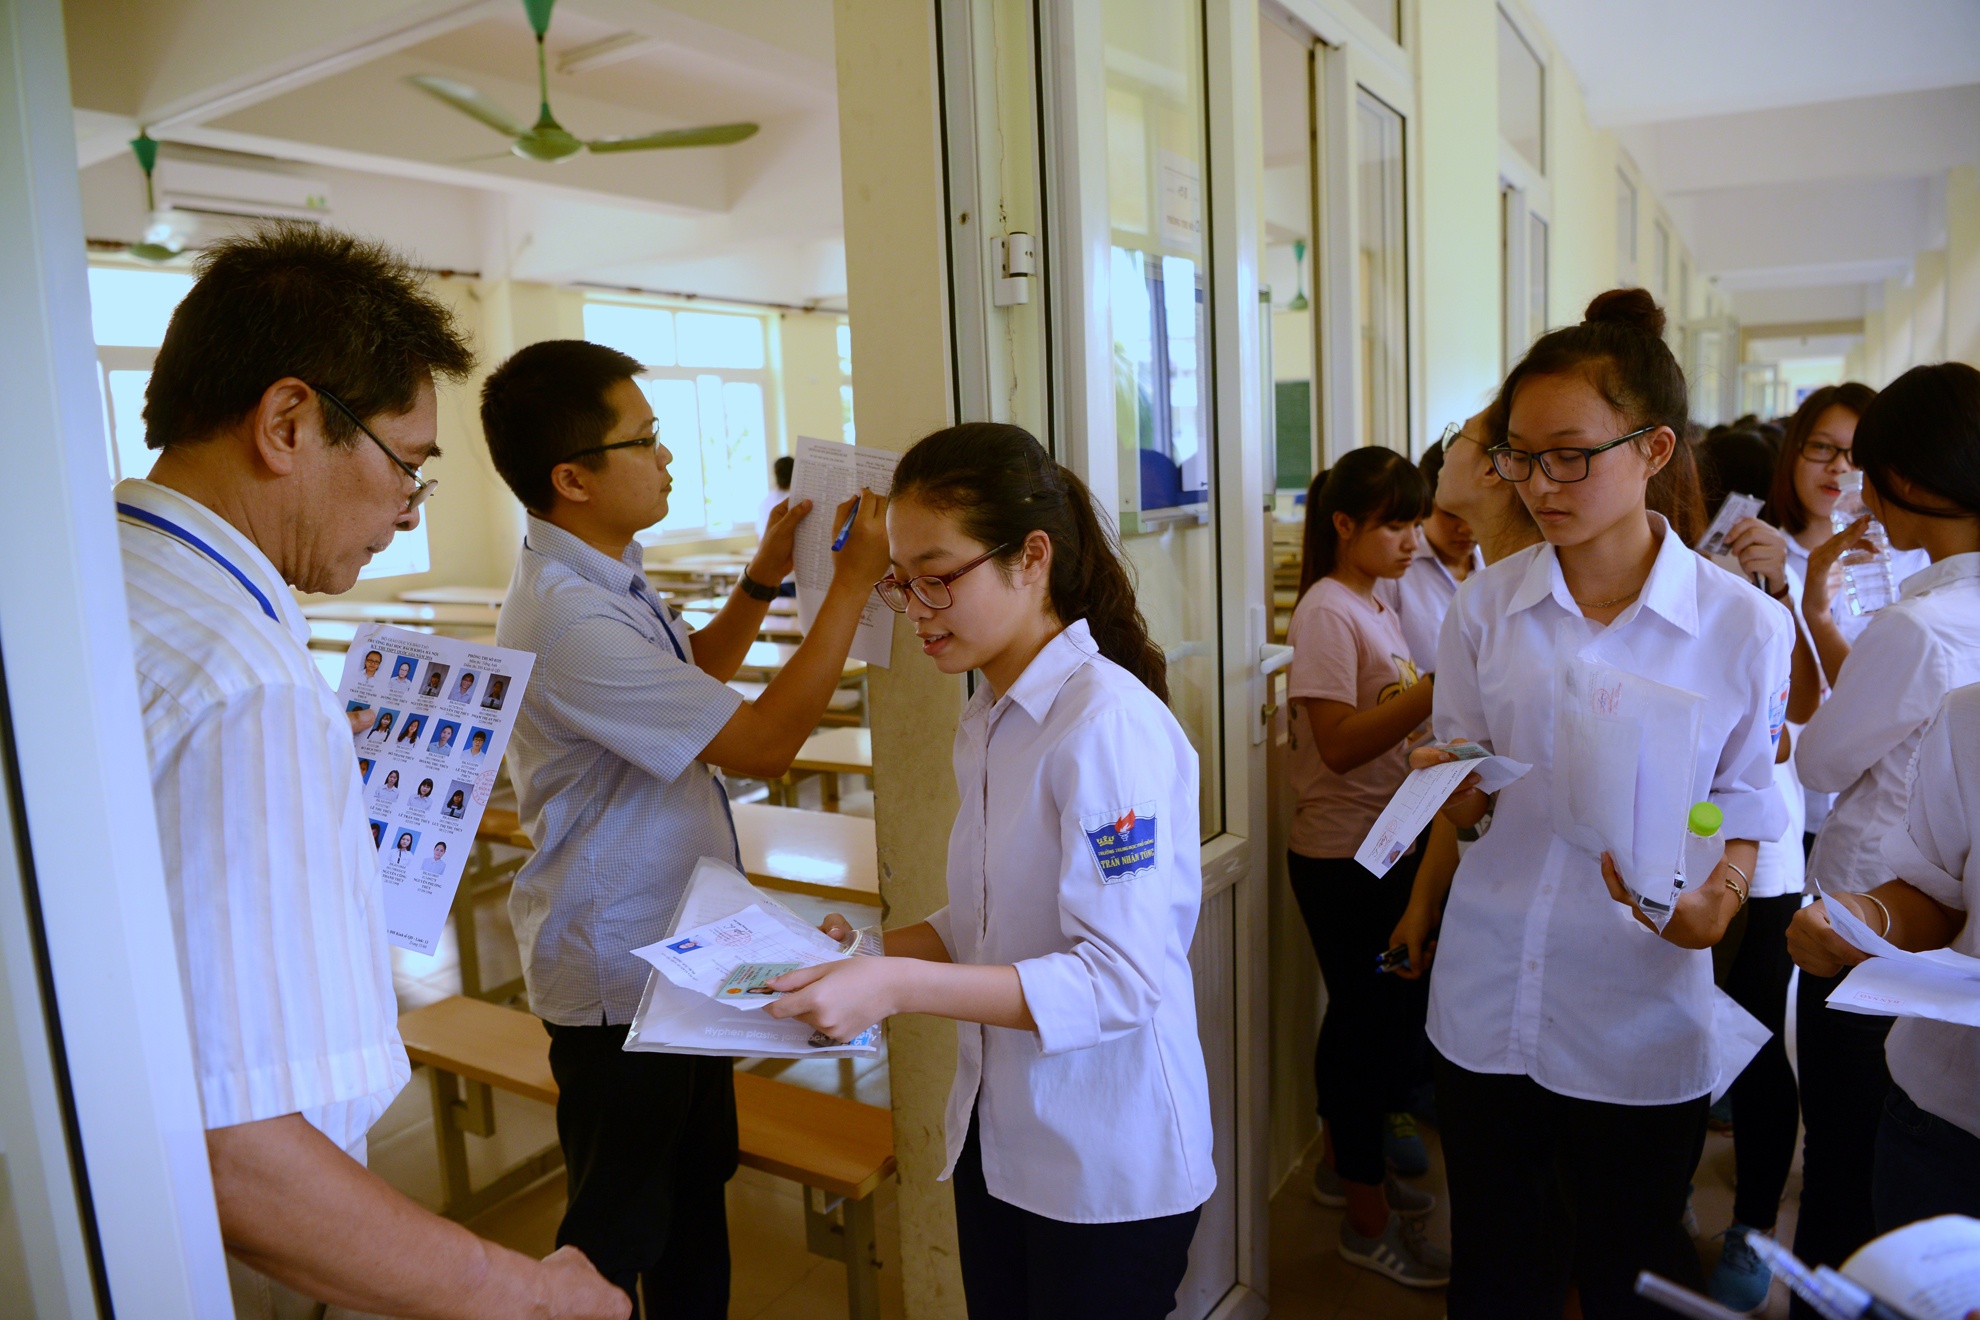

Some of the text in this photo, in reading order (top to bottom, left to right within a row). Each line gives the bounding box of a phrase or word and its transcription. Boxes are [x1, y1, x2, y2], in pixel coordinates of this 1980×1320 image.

[1101, 856, 1120, 868] TRẦN
[1122, 852, 1140, 865] NHÂN
[705, 1026, 826, 1042] Hyphen plastic joinstock
